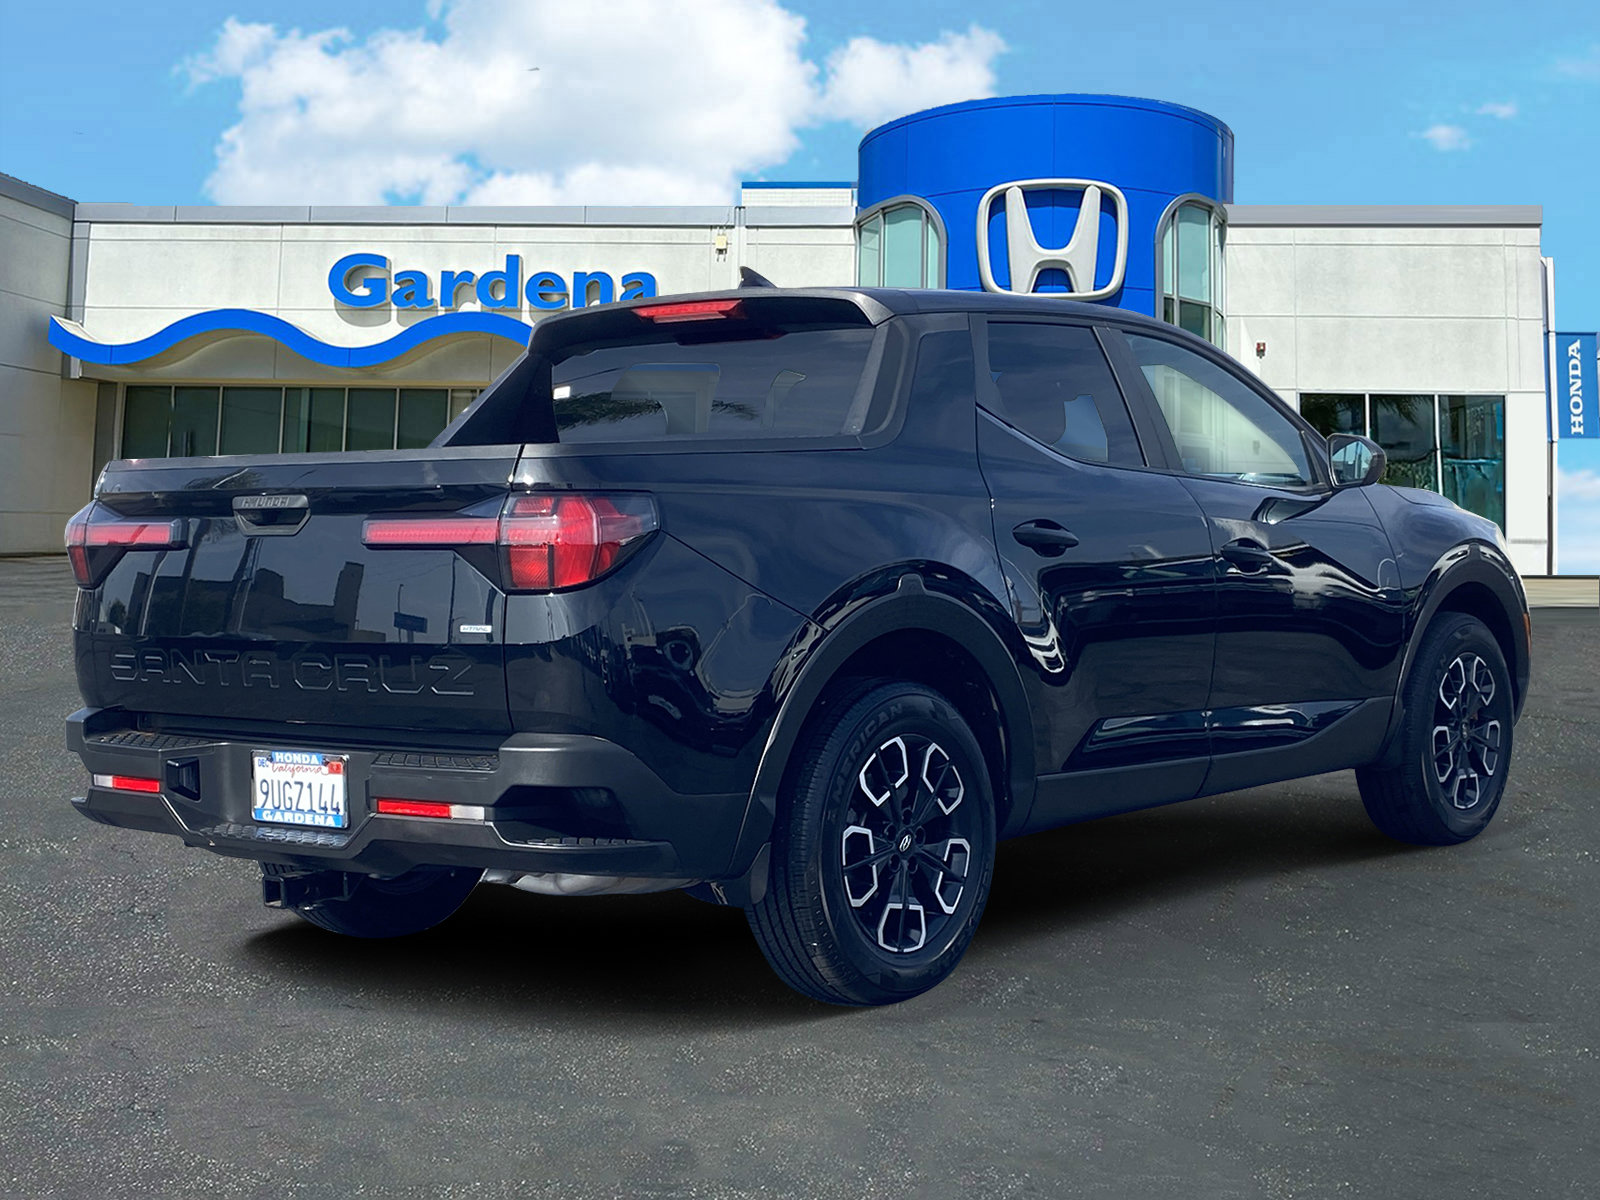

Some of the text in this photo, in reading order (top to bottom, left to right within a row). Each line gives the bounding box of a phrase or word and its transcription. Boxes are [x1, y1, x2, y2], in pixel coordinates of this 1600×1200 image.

[328, 253, 657, 308] Gardena
[1568, 339, 1584, 435] HONDA
[110, 647, 475, 697] SANTA CRUZ
[275, 751, 320, 765] HONDA
[260, 778, 341, 815] 9UGZ144
[262, 810, 336, 827] GARDENA
